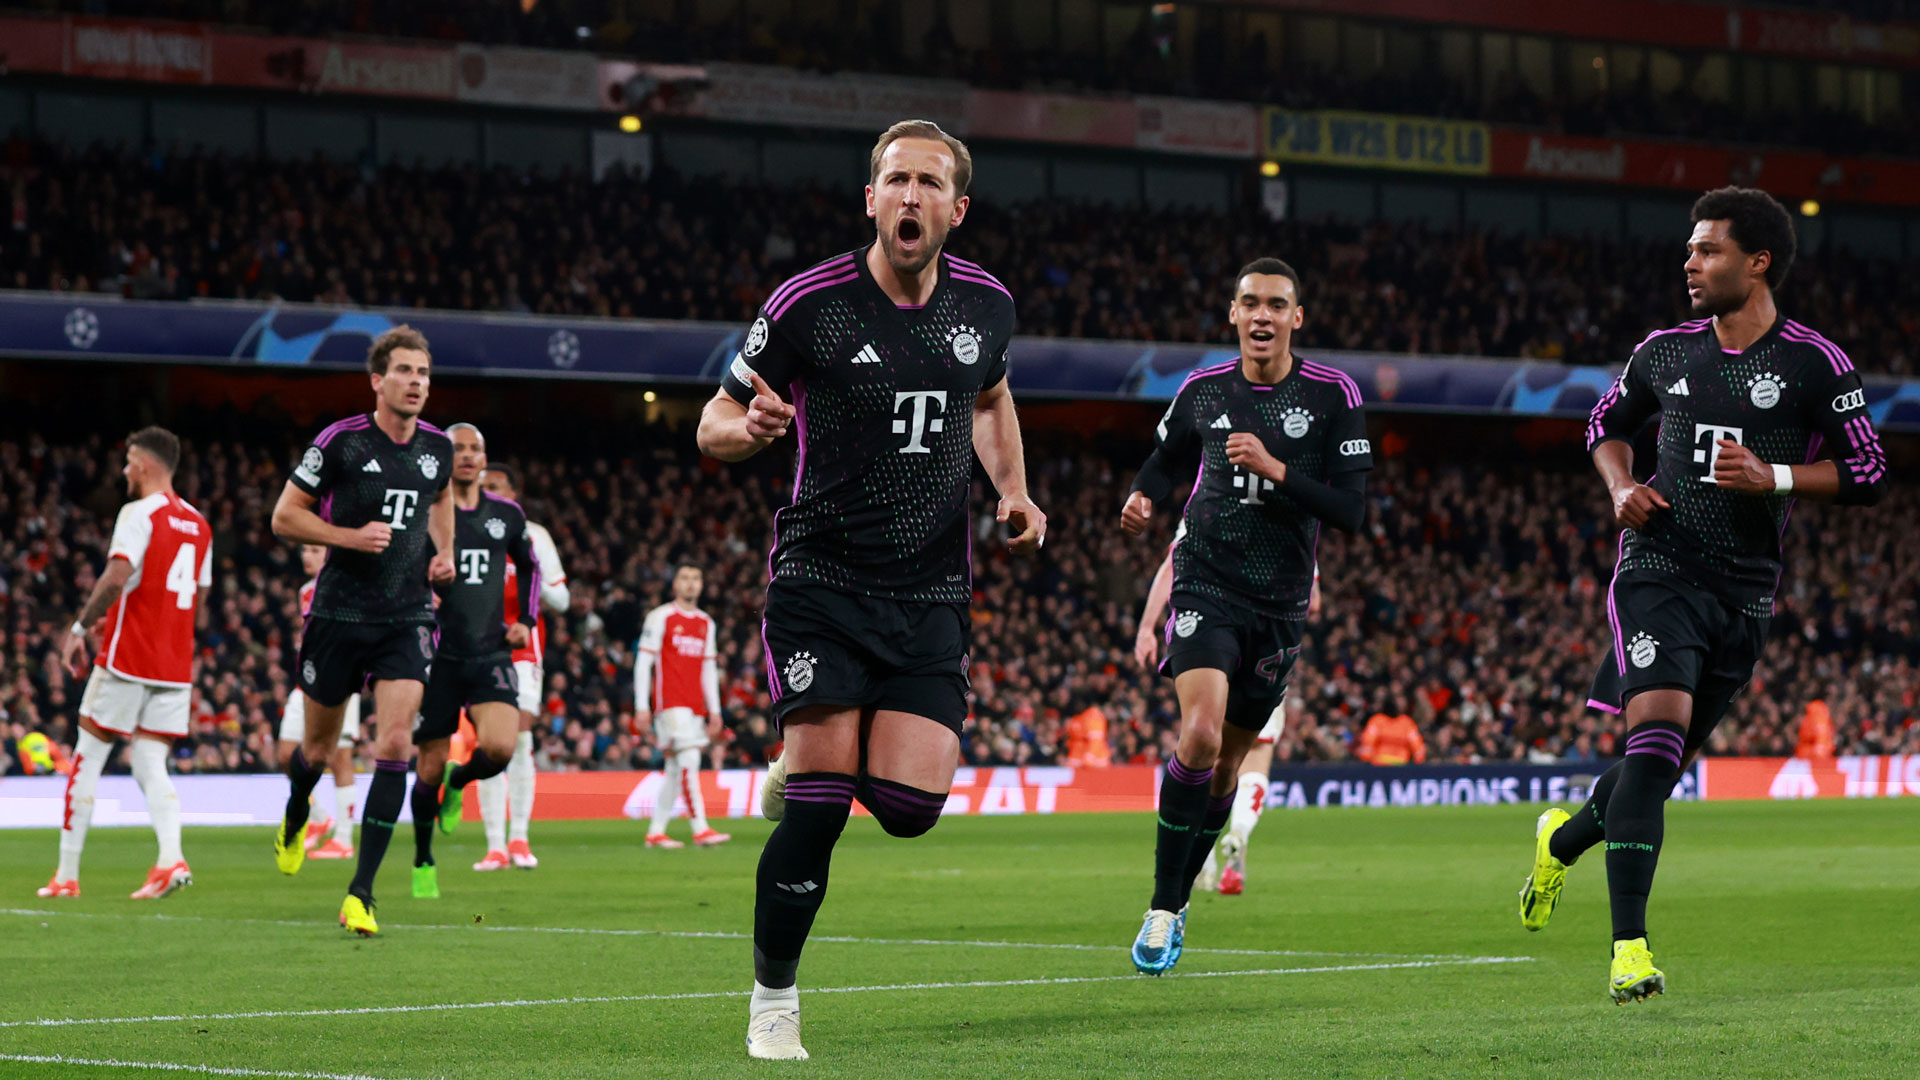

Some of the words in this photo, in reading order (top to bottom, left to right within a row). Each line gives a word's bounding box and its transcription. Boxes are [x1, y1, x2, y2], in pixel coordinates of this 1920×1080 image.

[317, 46, 453, 93] Arsenal
[1524, 136, 1624, 180] Arsenal
[892, 390, 947, 453] T
[168, 515, 200, 537] WHITE
[381, 488, 419, 530] T
[166, 541, 198, 611] 4
[460, 548, 490, 584] T
[416, 625, 433, 659] 8
[1316, 776, 1520, 809] CHAMPIONS
